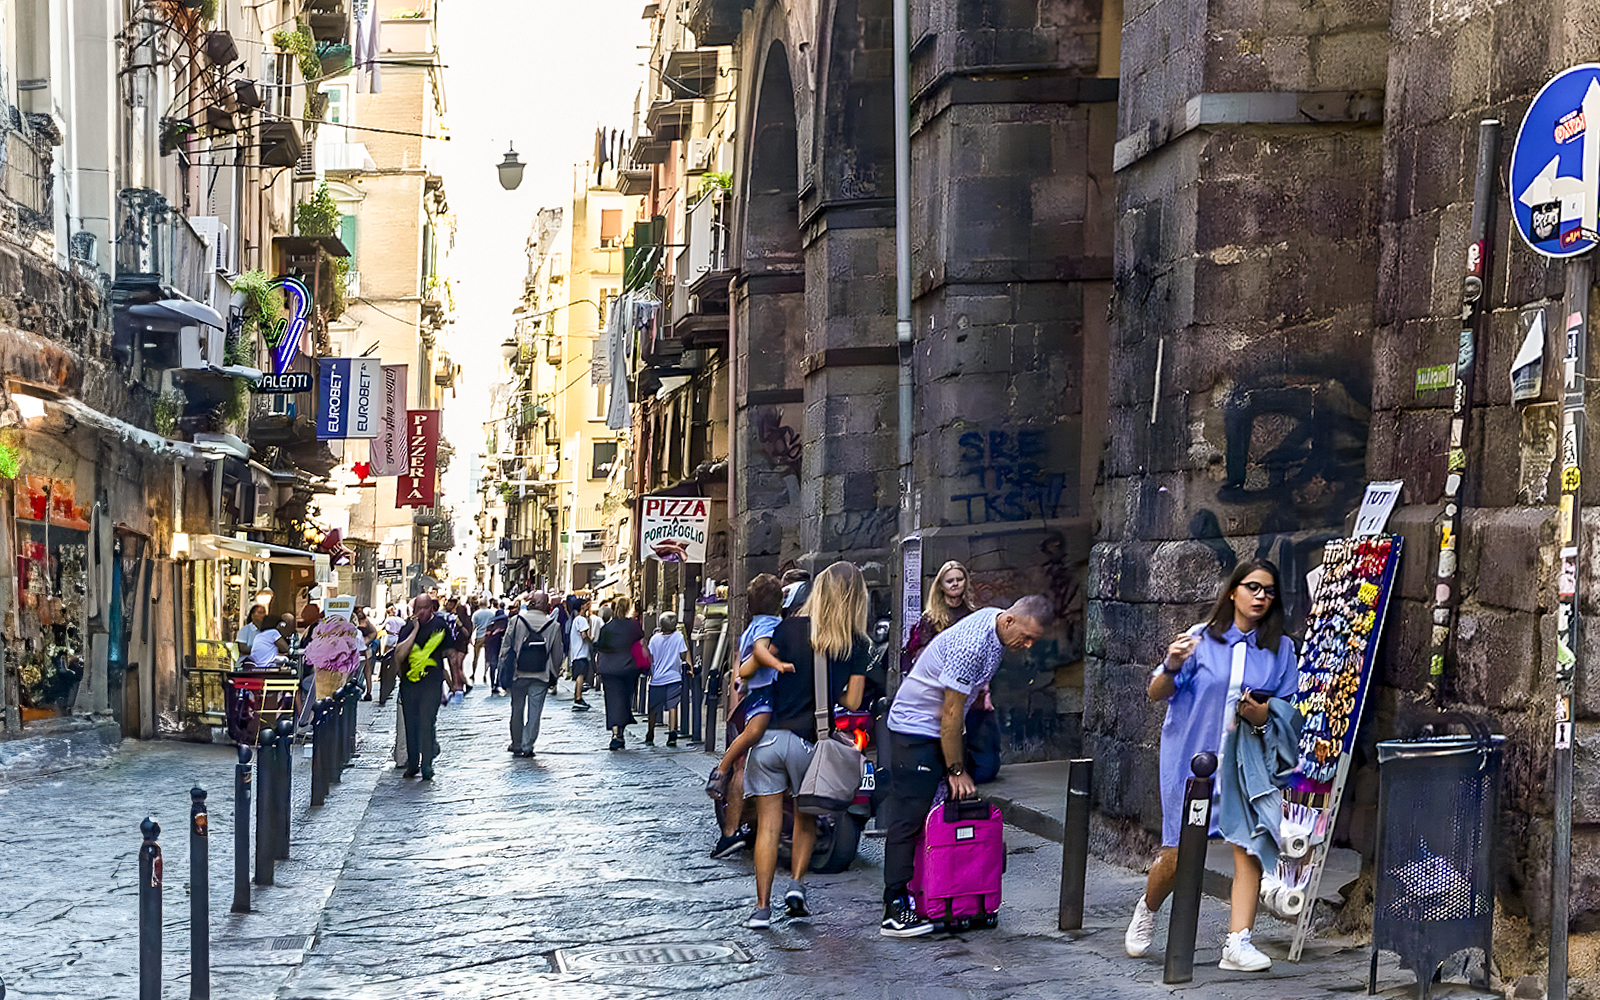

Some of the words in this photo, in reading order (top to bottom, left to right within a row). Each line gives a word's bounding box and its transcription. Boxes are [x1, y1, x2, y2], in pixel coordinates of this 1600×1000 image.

[254, 374, 308, 388] VALENTI
[407, 415, 428, 499] PIZZERIA
[646, 499, 707, 516] PIZZA
[644, 524, 704, 544] PORTAFOGLIO
